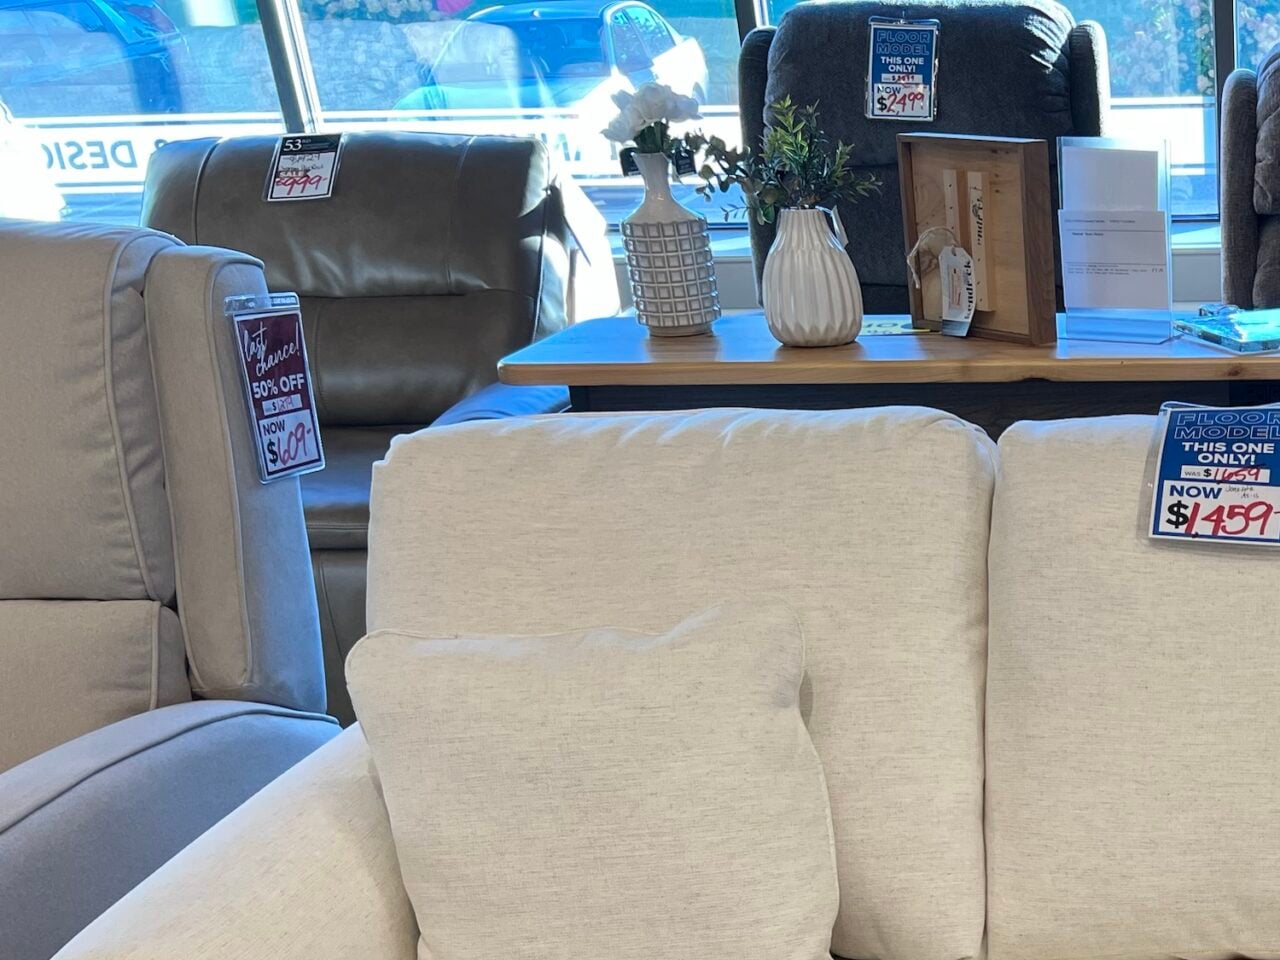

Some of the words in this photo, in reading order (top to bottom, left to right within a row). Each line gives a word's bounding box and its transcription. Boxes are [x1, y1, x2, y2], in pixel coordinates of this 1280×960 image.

[877, 30, 930, 43] FLOOR
[876, 43, 930, 56] MODEL
[881, 56, 902, 64] THIS
[903, 57, 925, 65] ONE
[888, 64, 916, 73] ONLY!
[877, 86, 902, 94] NOW
[283, 139, 303, 151] 53
[280, 171, 304, 179] SALE
[252, 378, 279, 399] 50%
[280, 373, 305, 392] OFF
[263, 419, 286, 436] NOW
[1182, 442, 1227, 452] THIS
[1232, 442, 1275, 454] ONE
[1198, 453, 1256, 465] ONLY!
[1169, 485, 1223, 499] NOW
